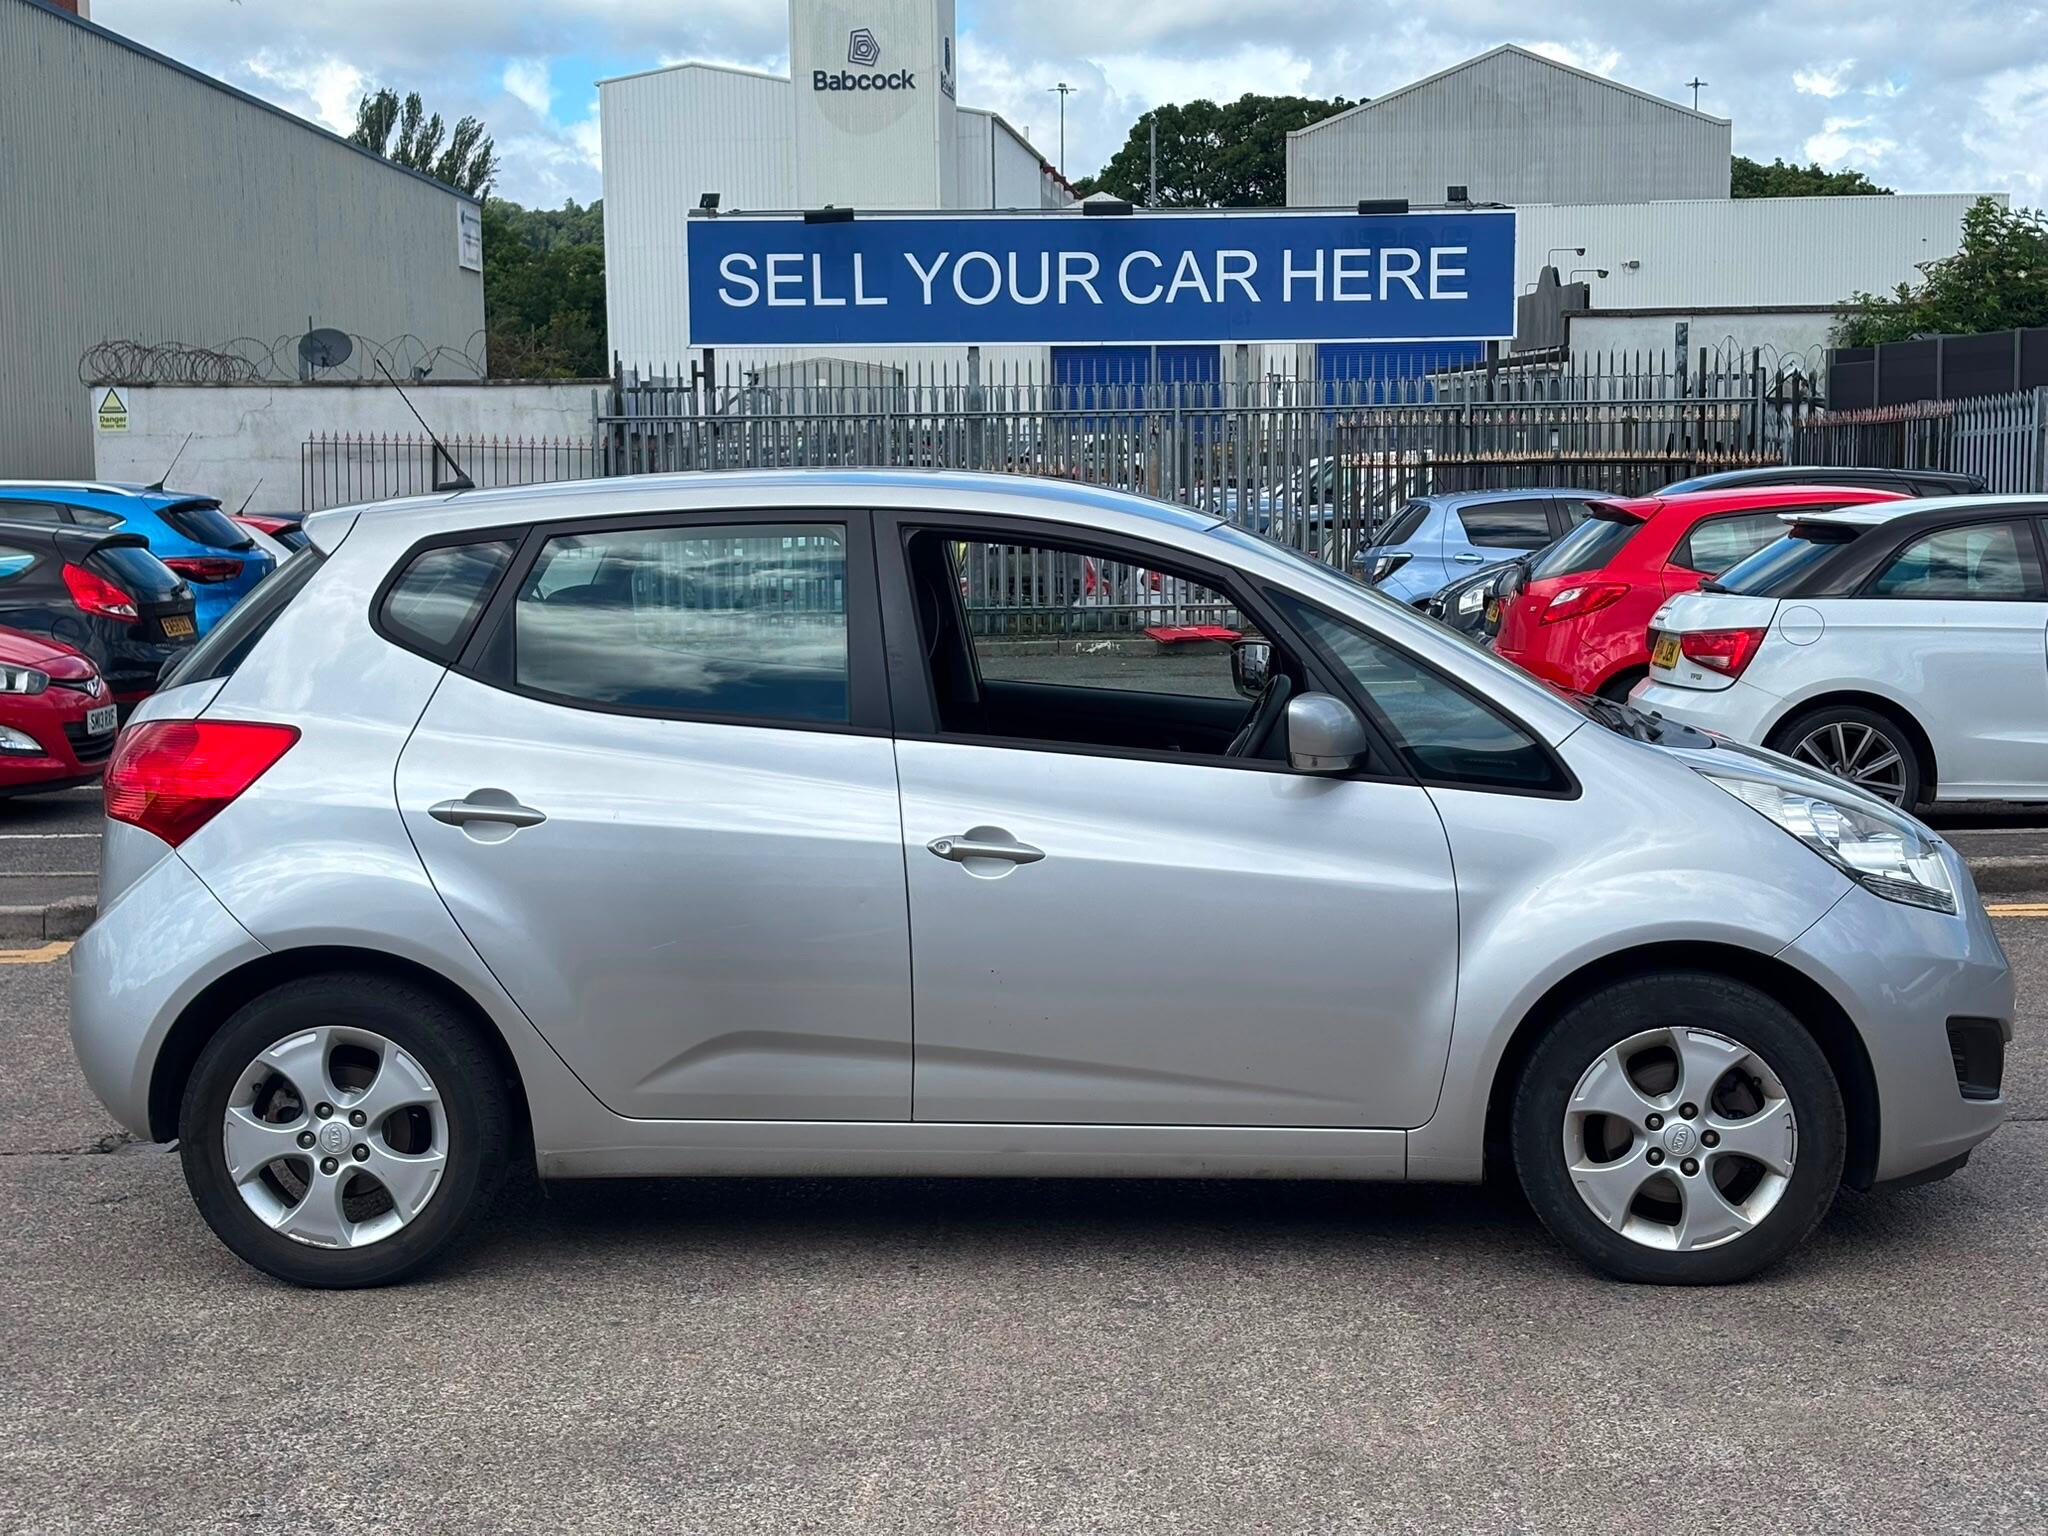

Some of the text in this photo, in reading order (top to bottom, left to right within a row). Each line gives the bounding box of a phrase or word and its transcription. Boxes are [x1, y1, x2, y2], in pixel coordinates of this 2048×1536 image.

[813, 69, 916, 91] Babcock
[718, 247, 1468, 307] SELL YOUR CAR HERE
[99, 416, 127, 424] Danger
[1673, 1130, 1688, 1150] KIA
